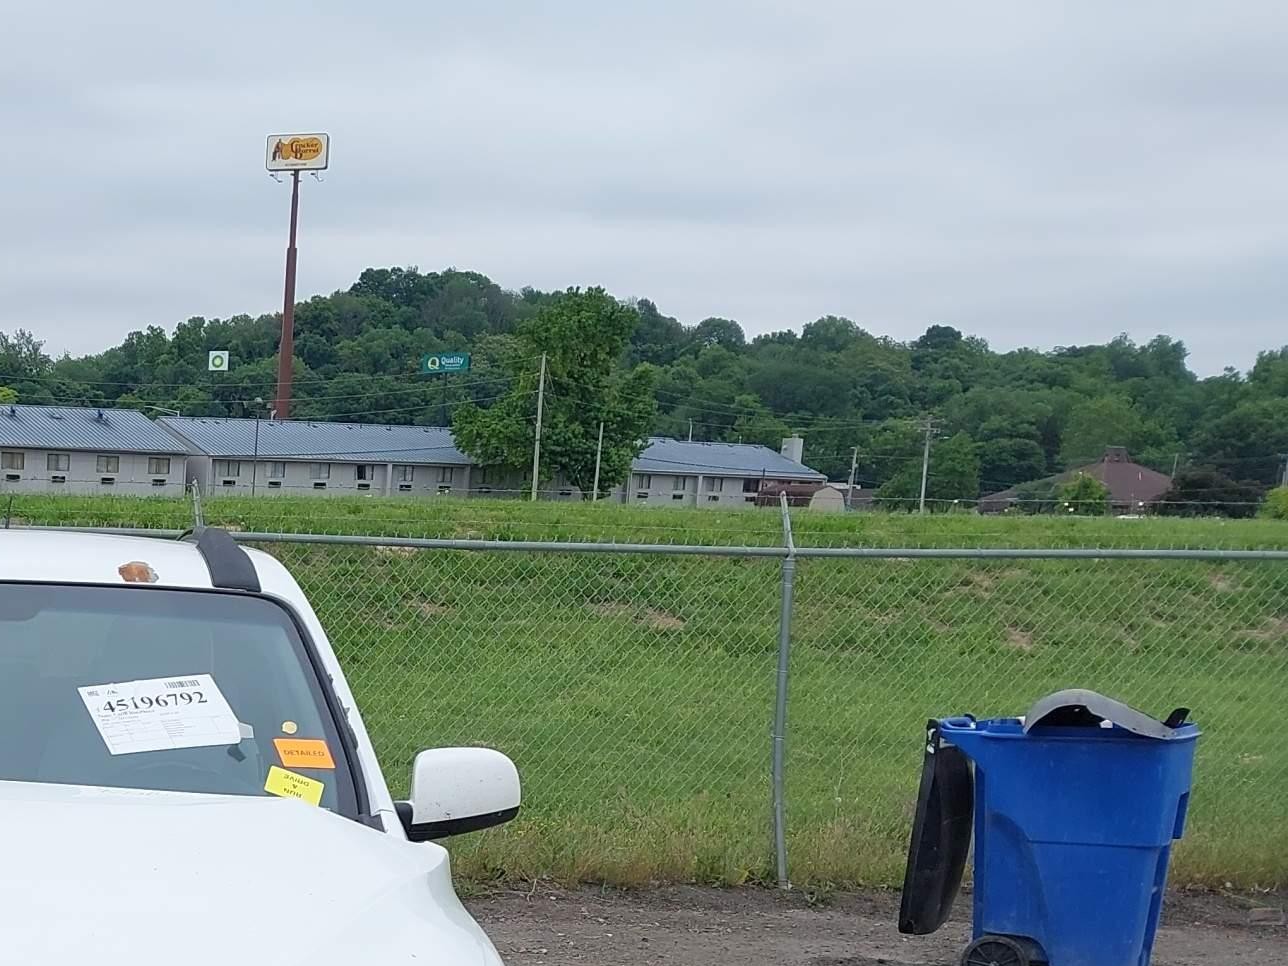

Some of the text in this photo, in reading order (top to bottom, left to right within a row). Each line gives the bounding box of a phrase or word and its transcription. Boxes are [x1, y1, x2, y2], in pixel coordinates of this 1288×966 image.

[441, 356, 464, 365] Quality
[103, 691, 208, 712] 45196792
[283, 749, 325, 757] DETAILED
[283, 773, 310, 787] DRIVE
